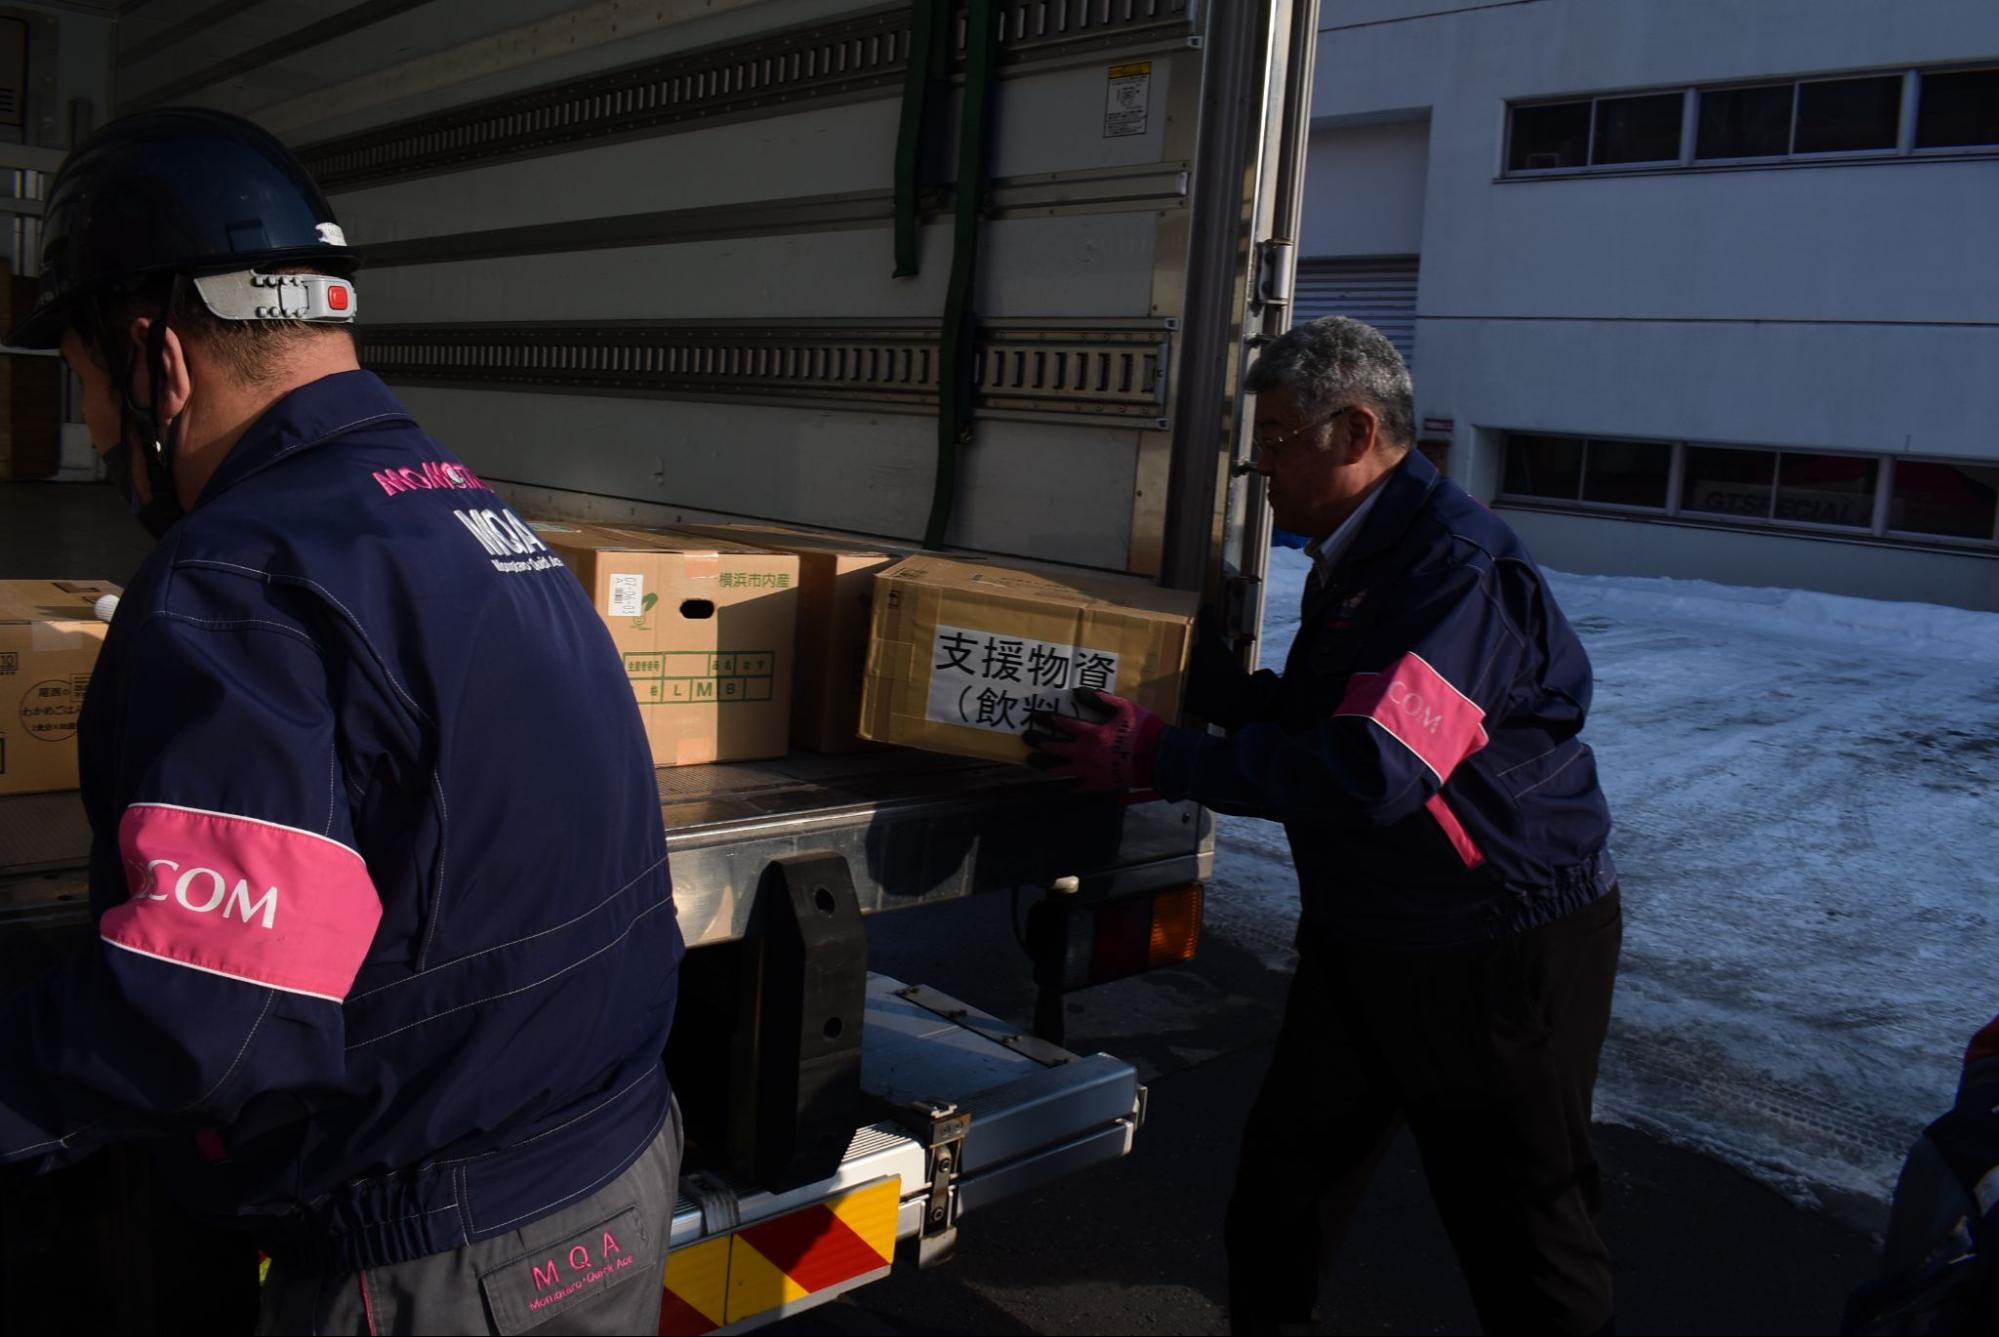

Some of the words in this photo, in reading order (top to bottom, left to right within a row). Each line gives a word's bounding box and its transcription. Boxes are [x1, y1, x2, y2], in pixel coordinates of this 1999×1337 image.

[719, 572, 791, 588] 横浜市内産
[936, 632, 1115, 690] 支援物資
[696, 682, 713, 697] M
[1388, 681, 1443, 734] COM
